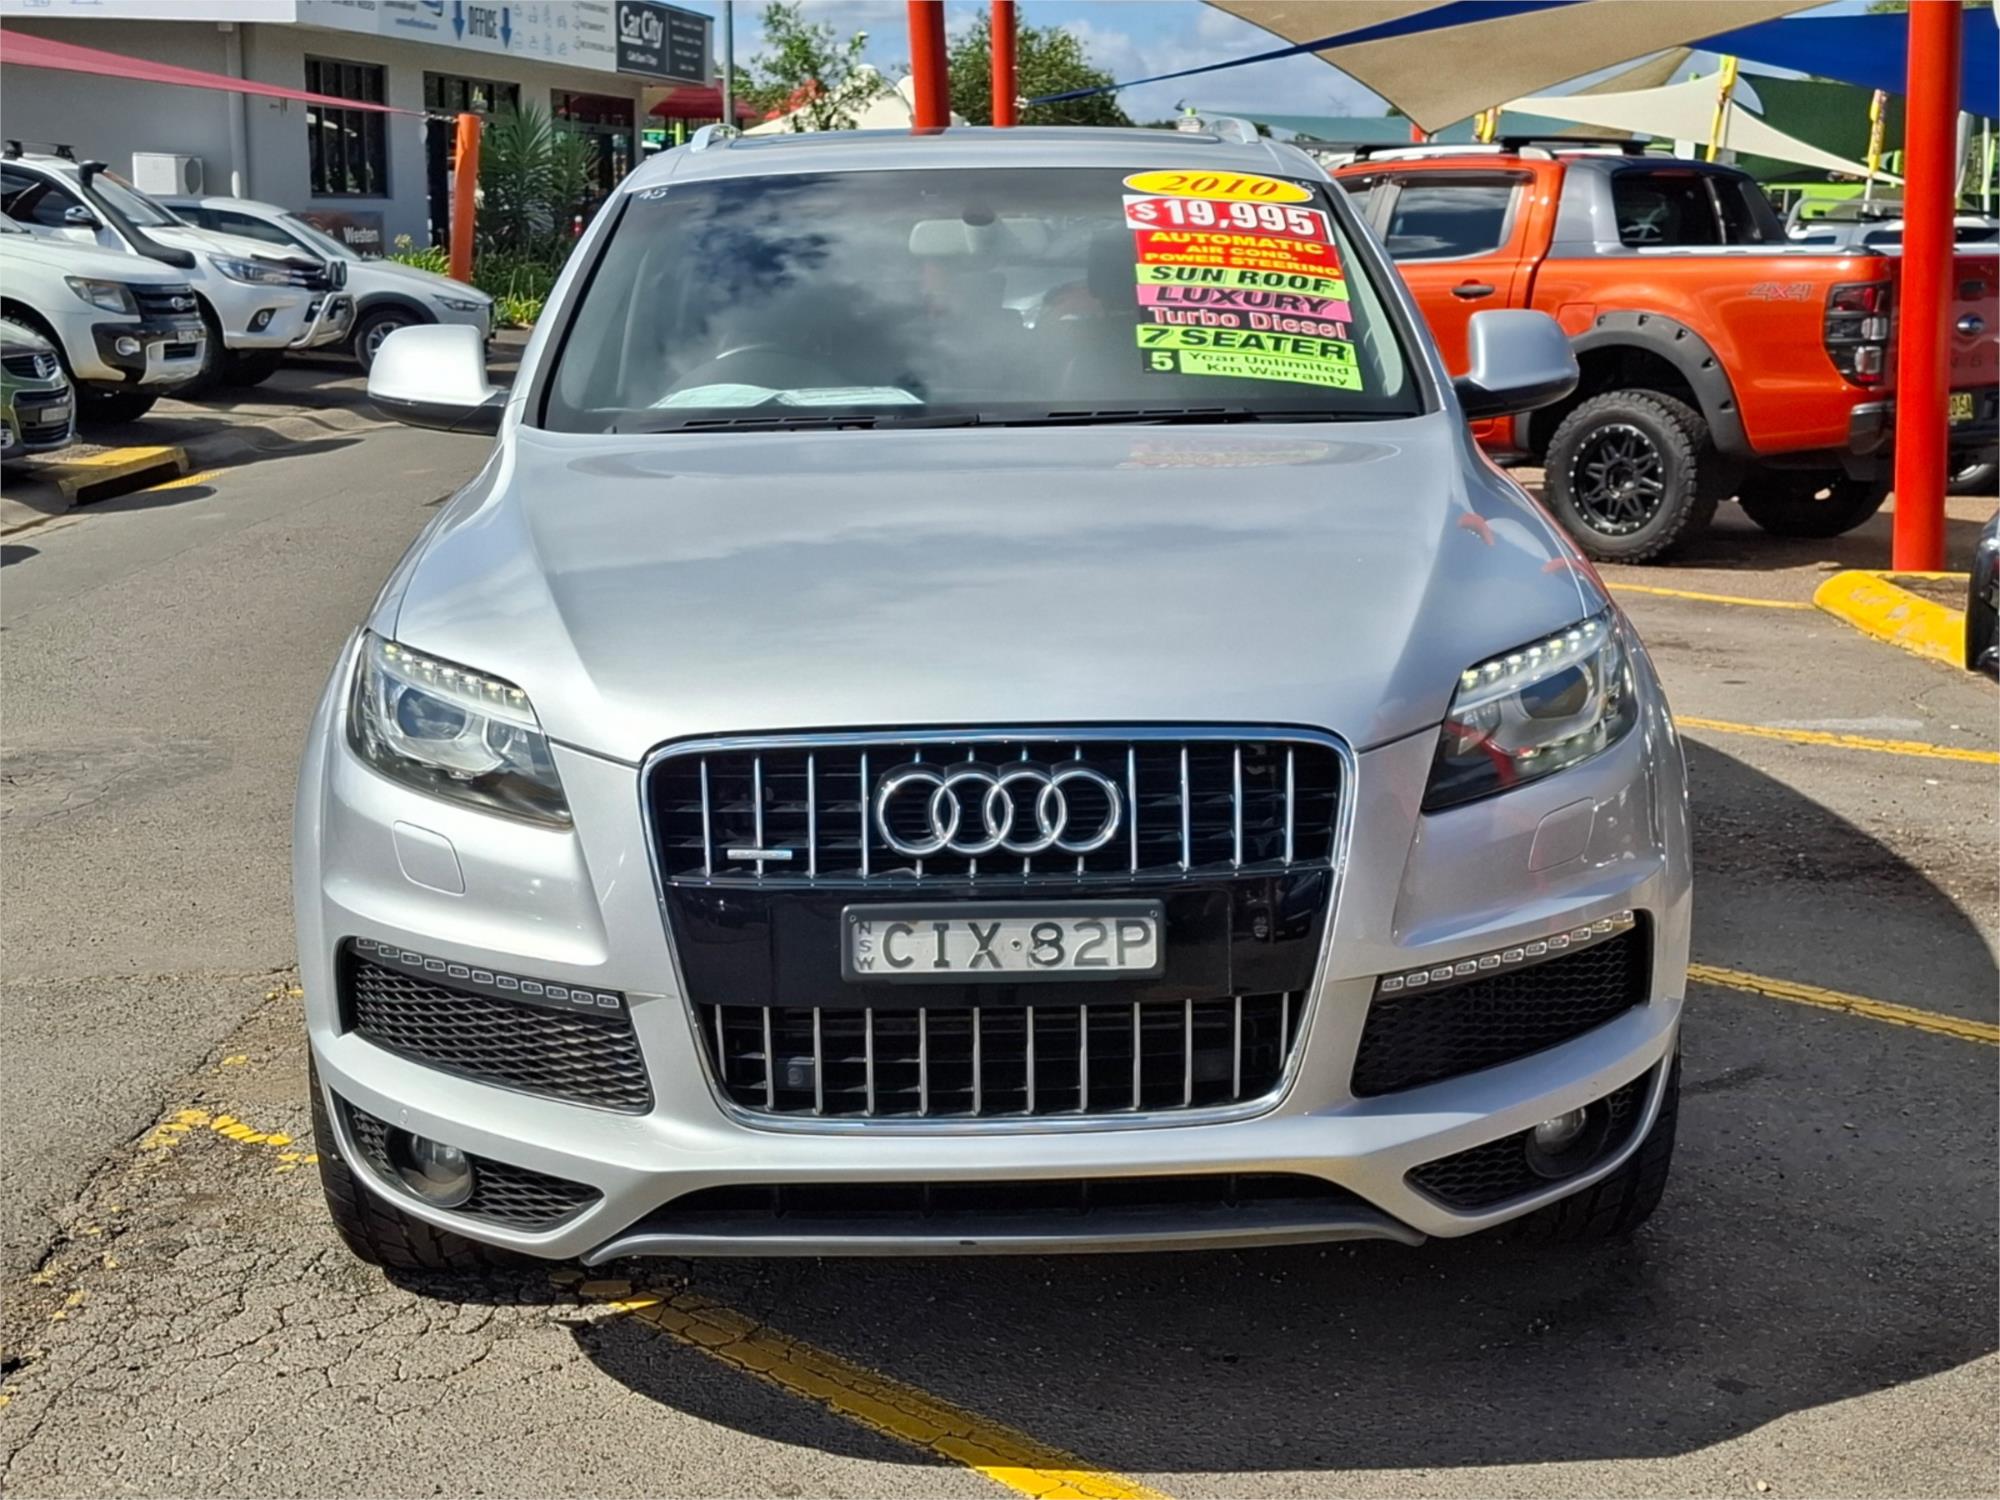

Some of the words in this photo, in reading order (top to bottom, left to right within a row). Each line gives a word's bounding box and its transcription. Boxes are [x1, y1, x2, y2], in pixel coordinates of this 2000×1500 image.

[468, 5, 498, 39] OFFICE
[1157, 174, 1280, 197] 2010
[1133, 198, 1316, 236] $19,995
[343, 226, 380, 244] Western
[1150, 231, 1325, 255] AUTOMATIC
[1145, 252, 1225, 265] POWER
[1229, 256, 1340, 276] STEERING
[1186, 244, 1225, 255] AIR
[1229, 247, 1299, 262] COND.
[1150, 266, 1229, 283] SUN
[1237, 269, 1335, 293] ROOF
[1156, 287, 1333, 315] LUXURY
[1148, 307, 1240, 328] Turbo
[1249, 312, 1347, 340] Diesel
[1142, 327, 1175, 345] 7
[1179, 329, 1349, 361] SEATER
[1151, 351, 1175, 371] 5
[1189, 352, 1239, 366] Year
[1243, 356, 1351, 376] Unlimited
[1206, 363, 1243, 374] Km
[1249, 365, 1348, 386] Warranty
[857, 920, 875, 971] NSW
